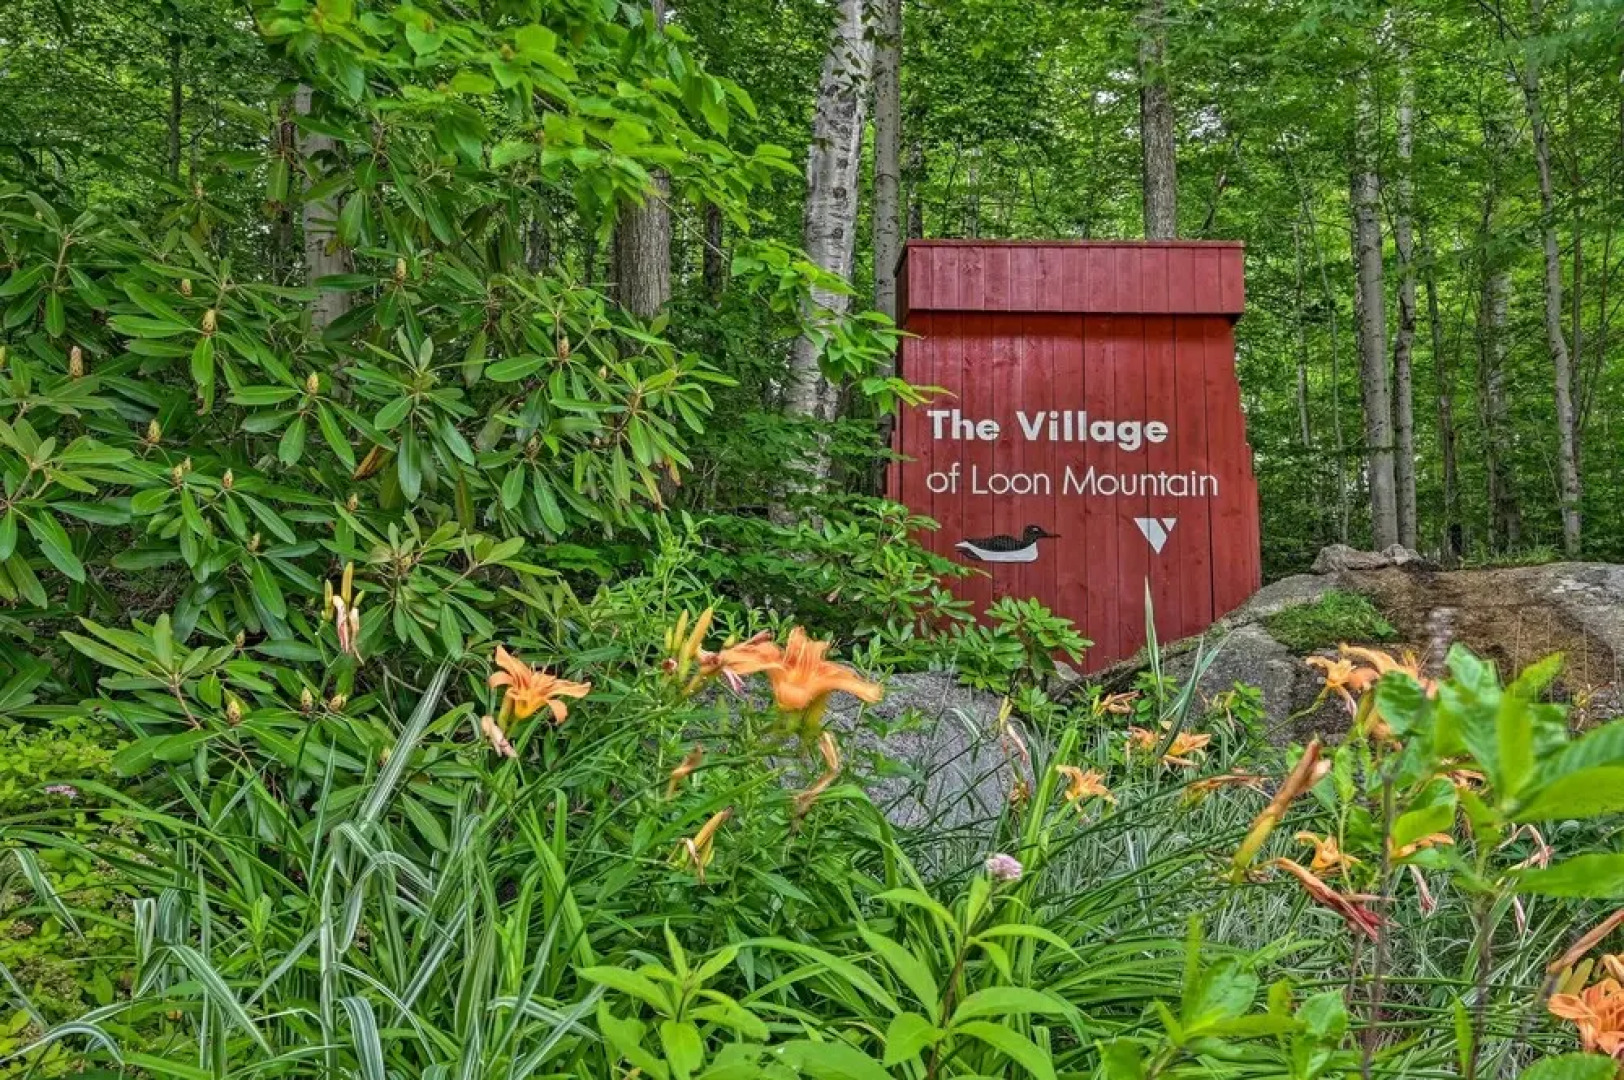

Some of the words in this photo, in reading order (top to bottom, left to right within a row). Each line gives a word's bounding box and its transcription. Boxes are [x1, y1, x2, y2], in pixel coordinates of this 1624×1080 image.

[927, 409, 1000, 441] The
[1016, 410, 1169, 452] Village
[926, 463, 961, 495] of
[972, 465, 1051, 496] Loon
[1062, 466, 1219, 498] Mountain
